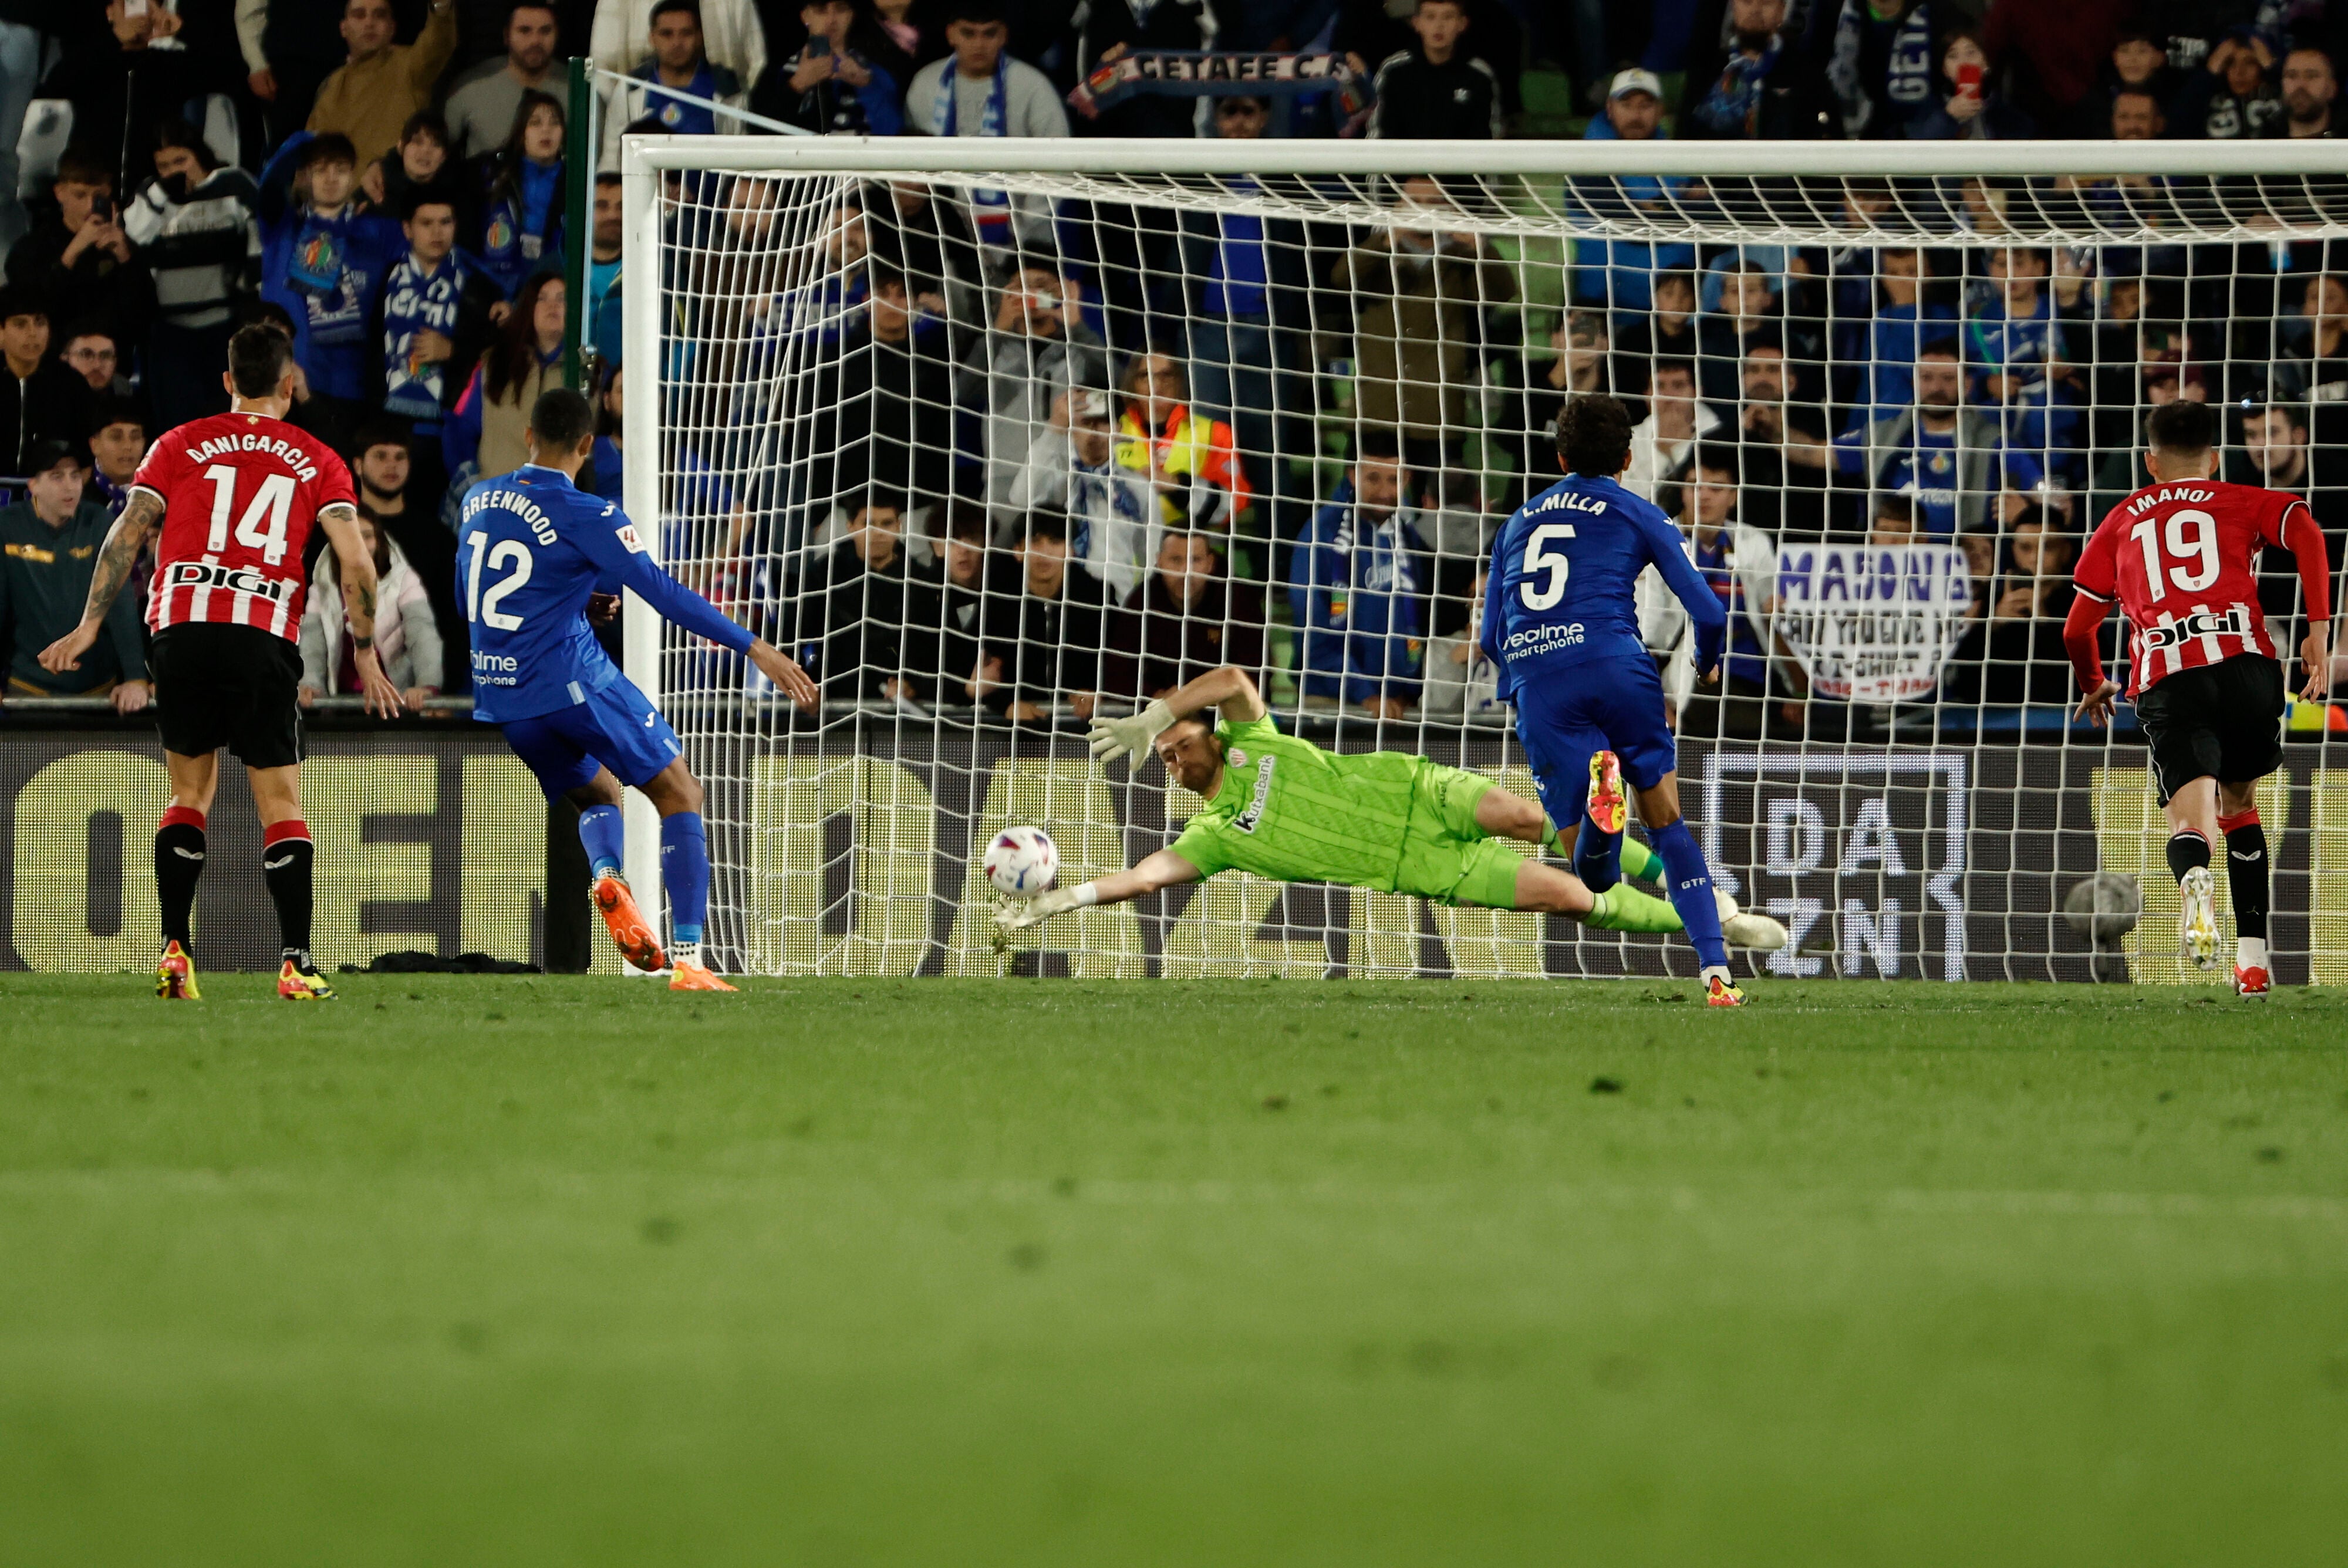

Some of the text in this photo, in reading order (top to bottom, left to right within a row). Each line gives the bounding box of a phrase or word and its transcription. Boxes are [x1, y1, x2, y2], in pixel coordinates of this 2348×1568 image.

[203, 464, 296, 567] 14
[463, 490, 558, 546] GREENWOOD
[171, 564, 282, 600] DIGI
[467, 530, 534, 631] 12
[1520, 524, 1577, 611] 5
[2130, 509, 2221, 604] 19
[1503, 623, 1584, 651] realme
[2147, 611, 2241, 648] DIGI
[1233, 754, 1274, 832] Kutxabank
[1681, 877, 1706, 890] GTF
